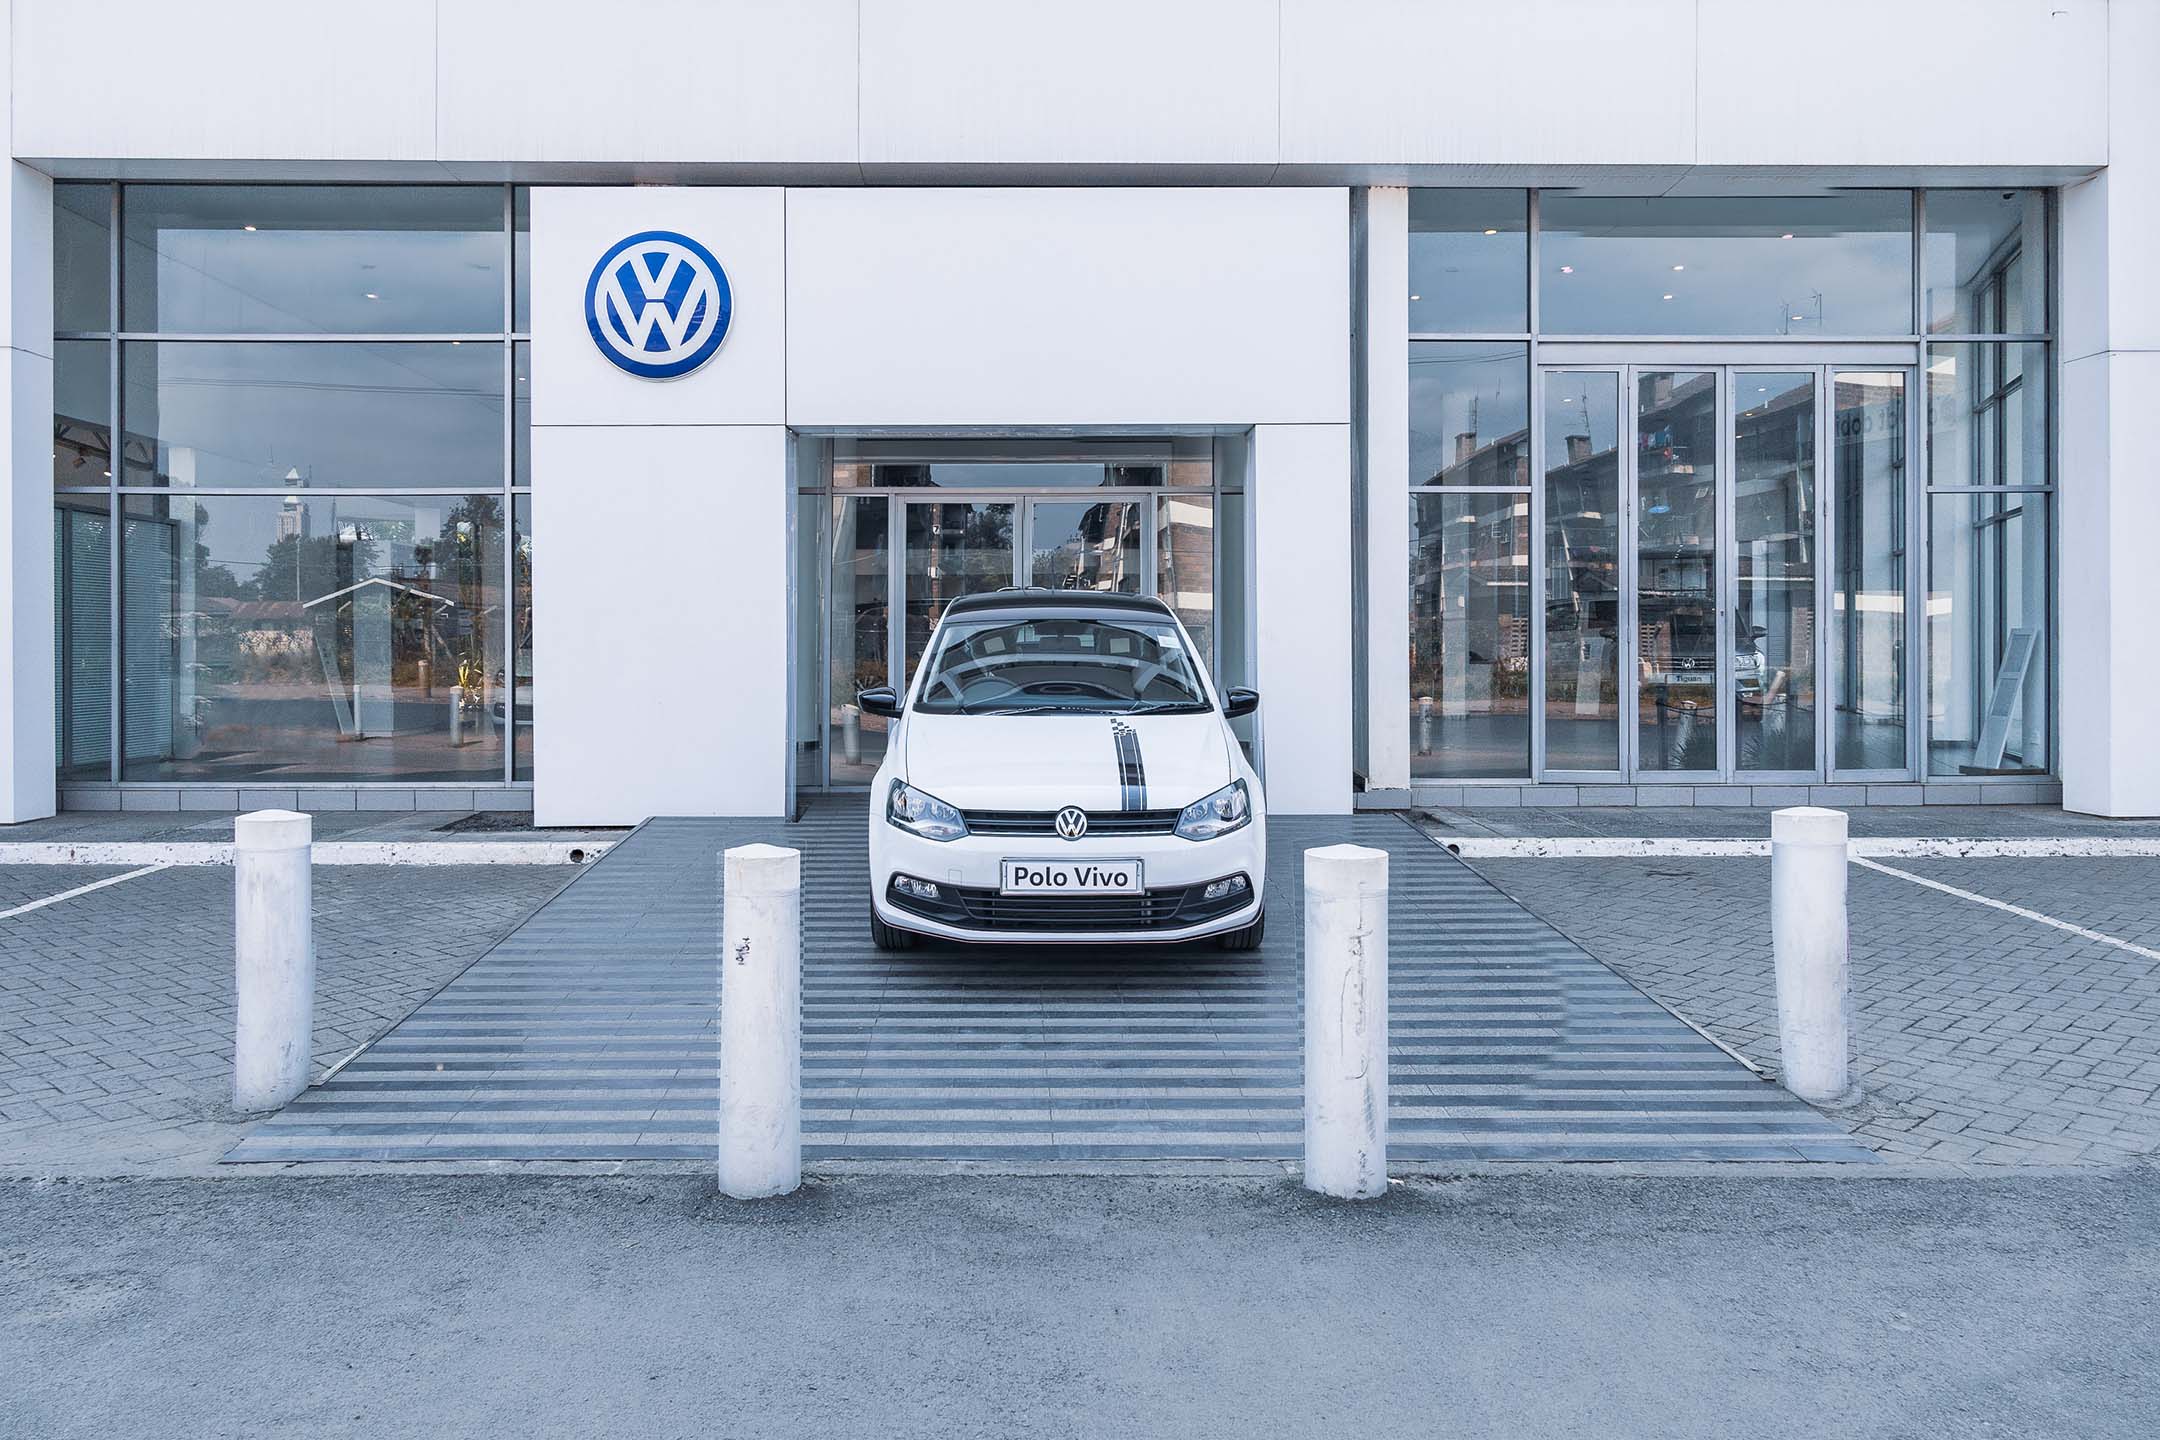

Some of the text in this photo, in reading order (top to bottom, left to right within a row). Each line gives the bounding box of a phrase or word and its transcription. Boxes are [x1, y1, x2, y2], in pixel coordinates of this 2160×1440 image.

[592, 237, 723, 368] VW
[1055, 807, 1088, 839] VW
[1014, 866, 1129, 887] Polo Vivo
